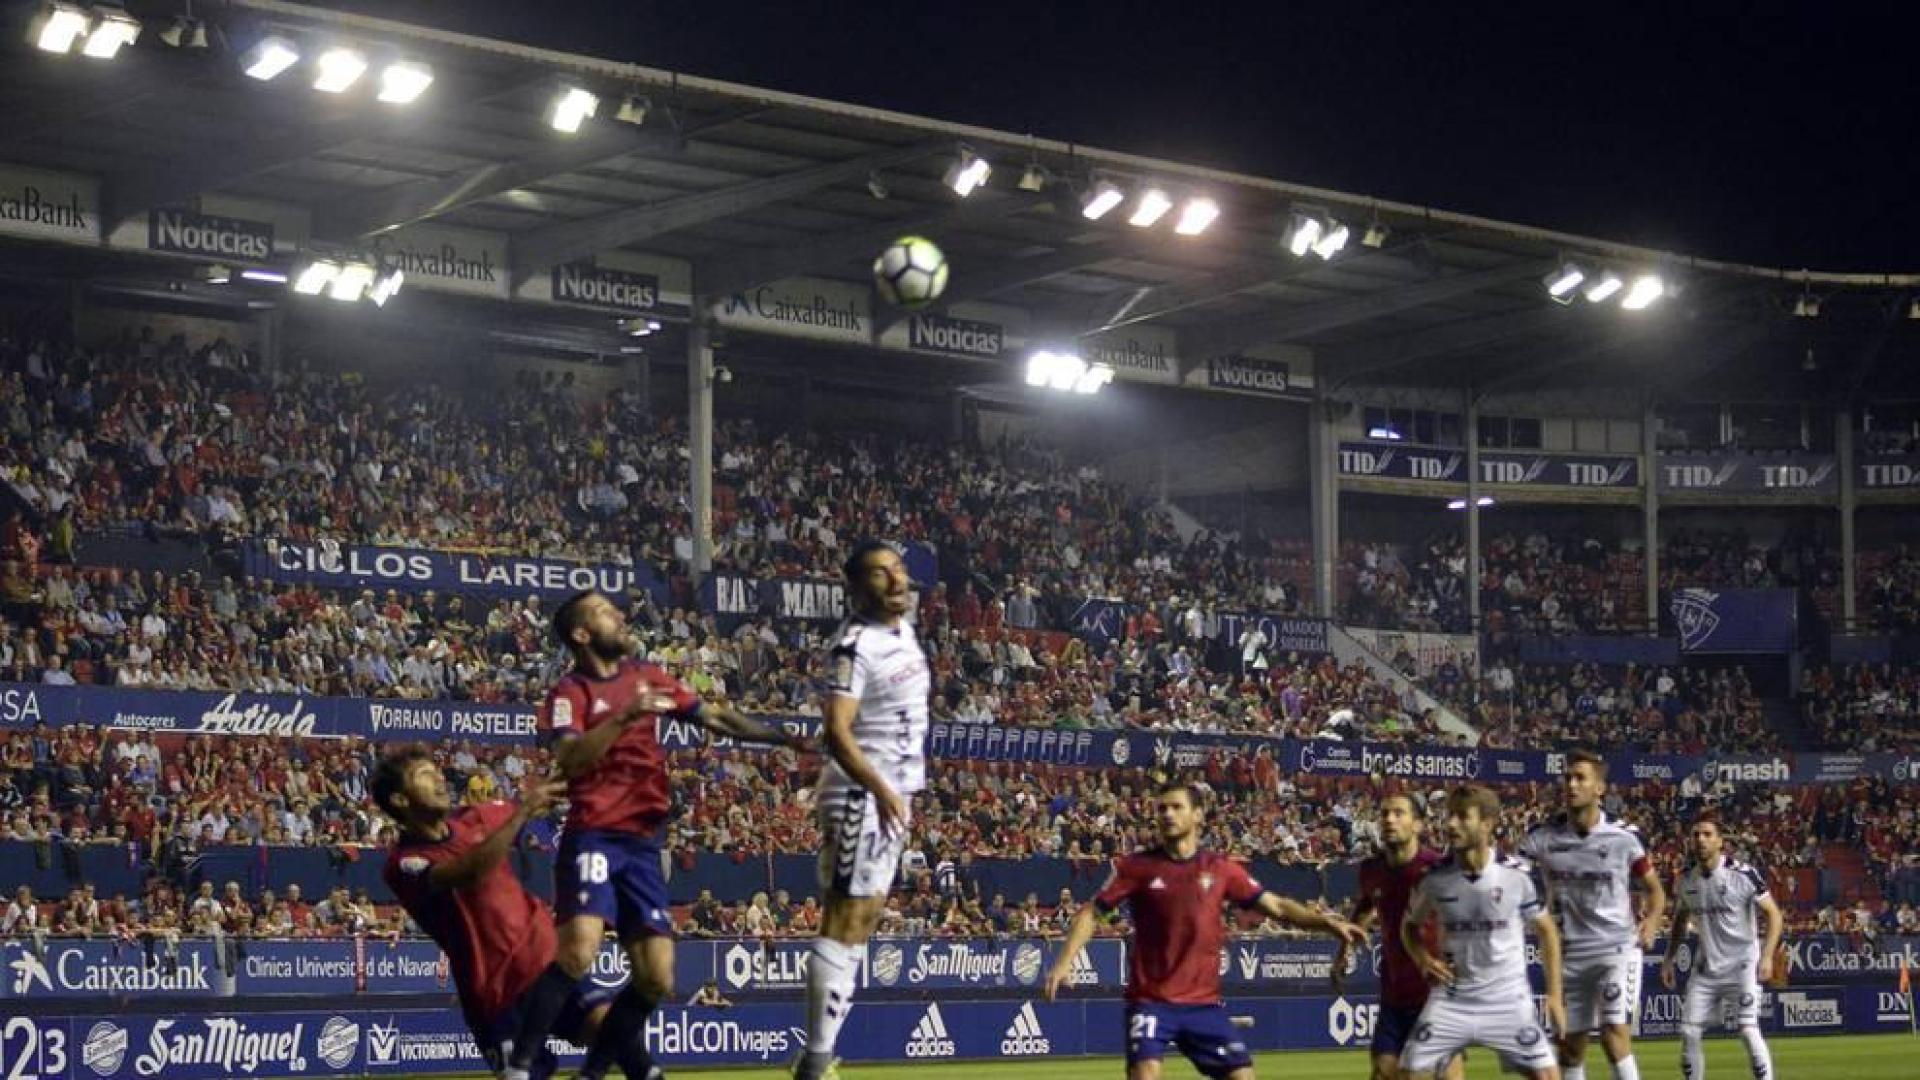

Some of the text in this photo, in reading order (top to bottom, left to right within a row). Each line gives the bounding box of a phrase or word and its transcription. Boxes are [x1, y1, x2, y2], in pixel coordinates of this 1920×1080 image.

[156, 210, 269, 259] Noticias
[559, 264, 654, 308] Noticias
[755, 287, 864, 333] CaixaBank
[916, 316, 999, 355] Noticias
[279, 544, 434, 580] CICLOS
[0, 689, 42, 721] SA
[199, 693, 317, 737] Artieda
[451, 711, 538, 736] PASTELER
[1415, 753, 1466, 778] sanas
[576, 852, 609, 884] 18
[57, 948, 211, 990] CaixaBank
[295, 954, 375, 978] Universid
[378, 953, 395, 977] de
[1877, 991, 1911, 1011] DN
[1130, 1014, 1158, 1038] 21
[905, 1037, 955, 1057] adidas
[1002, 1036, 1050, 1056] adidas
